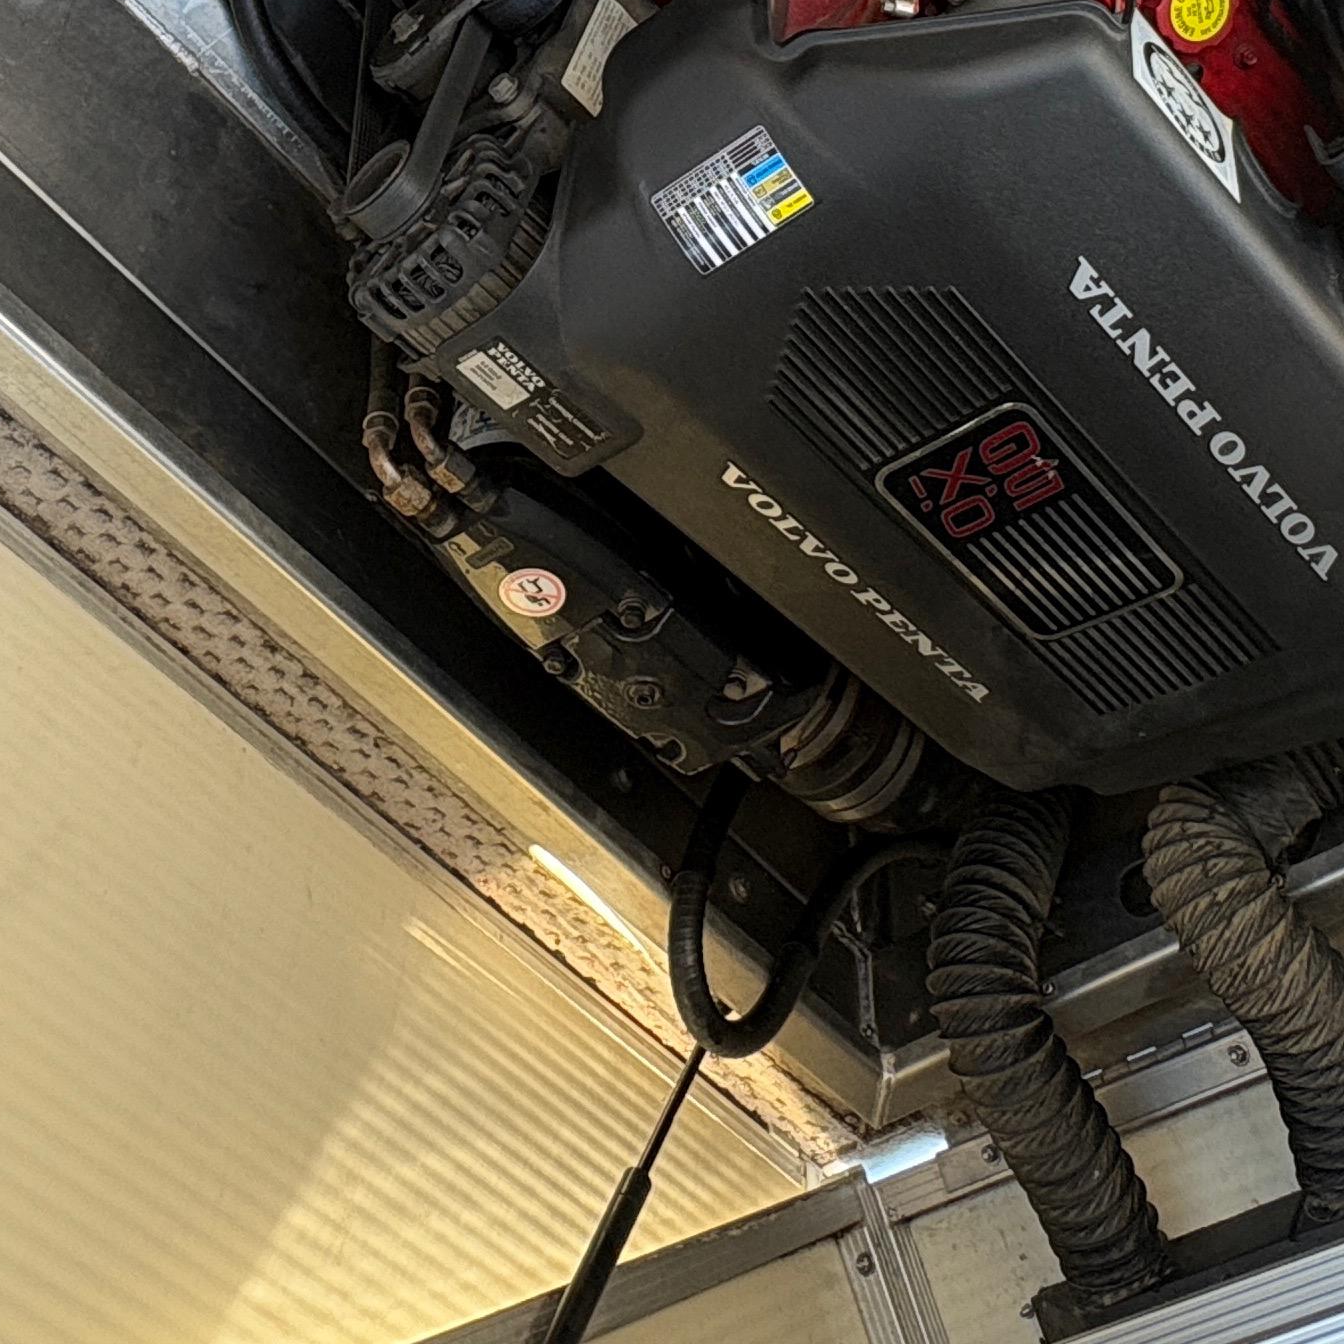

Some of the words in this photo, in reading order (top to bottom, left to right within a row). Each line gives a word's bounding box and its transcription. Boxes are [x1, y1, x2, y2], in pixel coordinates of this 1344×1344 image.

[1174, 6, 1195, 37] ENGINE
[487, 347, 536, 393] PENTA
[497, 342, 546, 388] VOLVO
[1069, 256, 1222, 436] PENTA
[1210, 431, 1338, 581] VOLVO
[721, 460, 859, 585] VOLVO
[850, 587, 990, 704] PENTA
